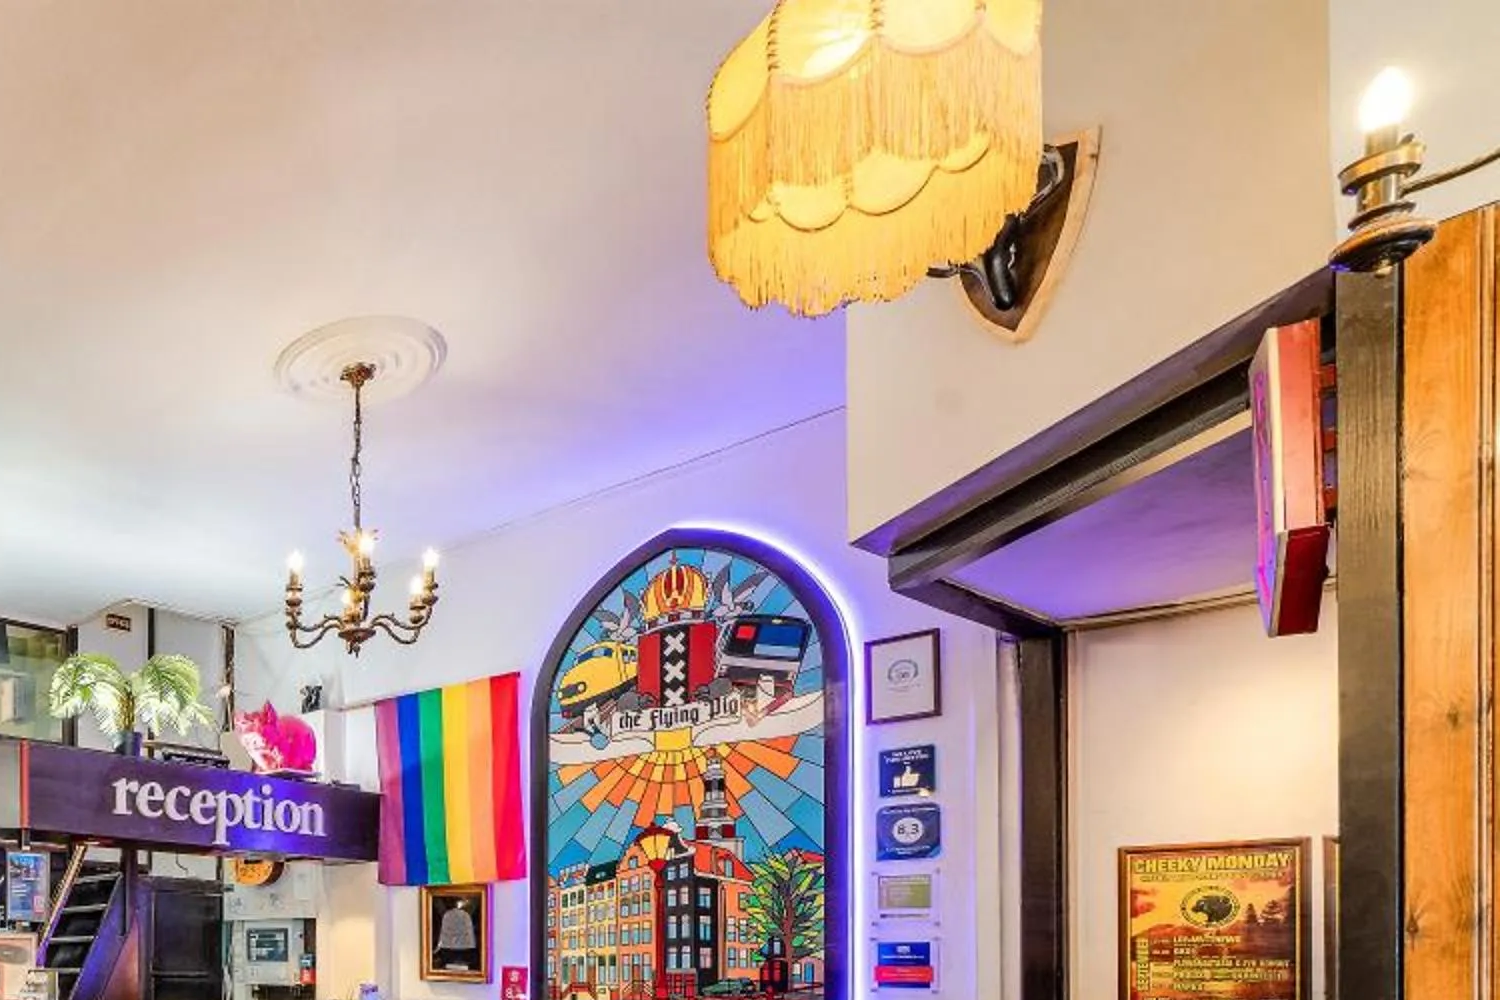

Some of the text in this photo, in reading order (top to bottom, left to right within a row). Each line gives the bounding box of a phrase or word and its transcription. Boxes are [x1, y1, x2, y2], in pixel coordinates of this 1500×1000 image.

[111, 777, 328, 846] reception
[1134, 850, 1291, 874] CHEEKY MONDAY
